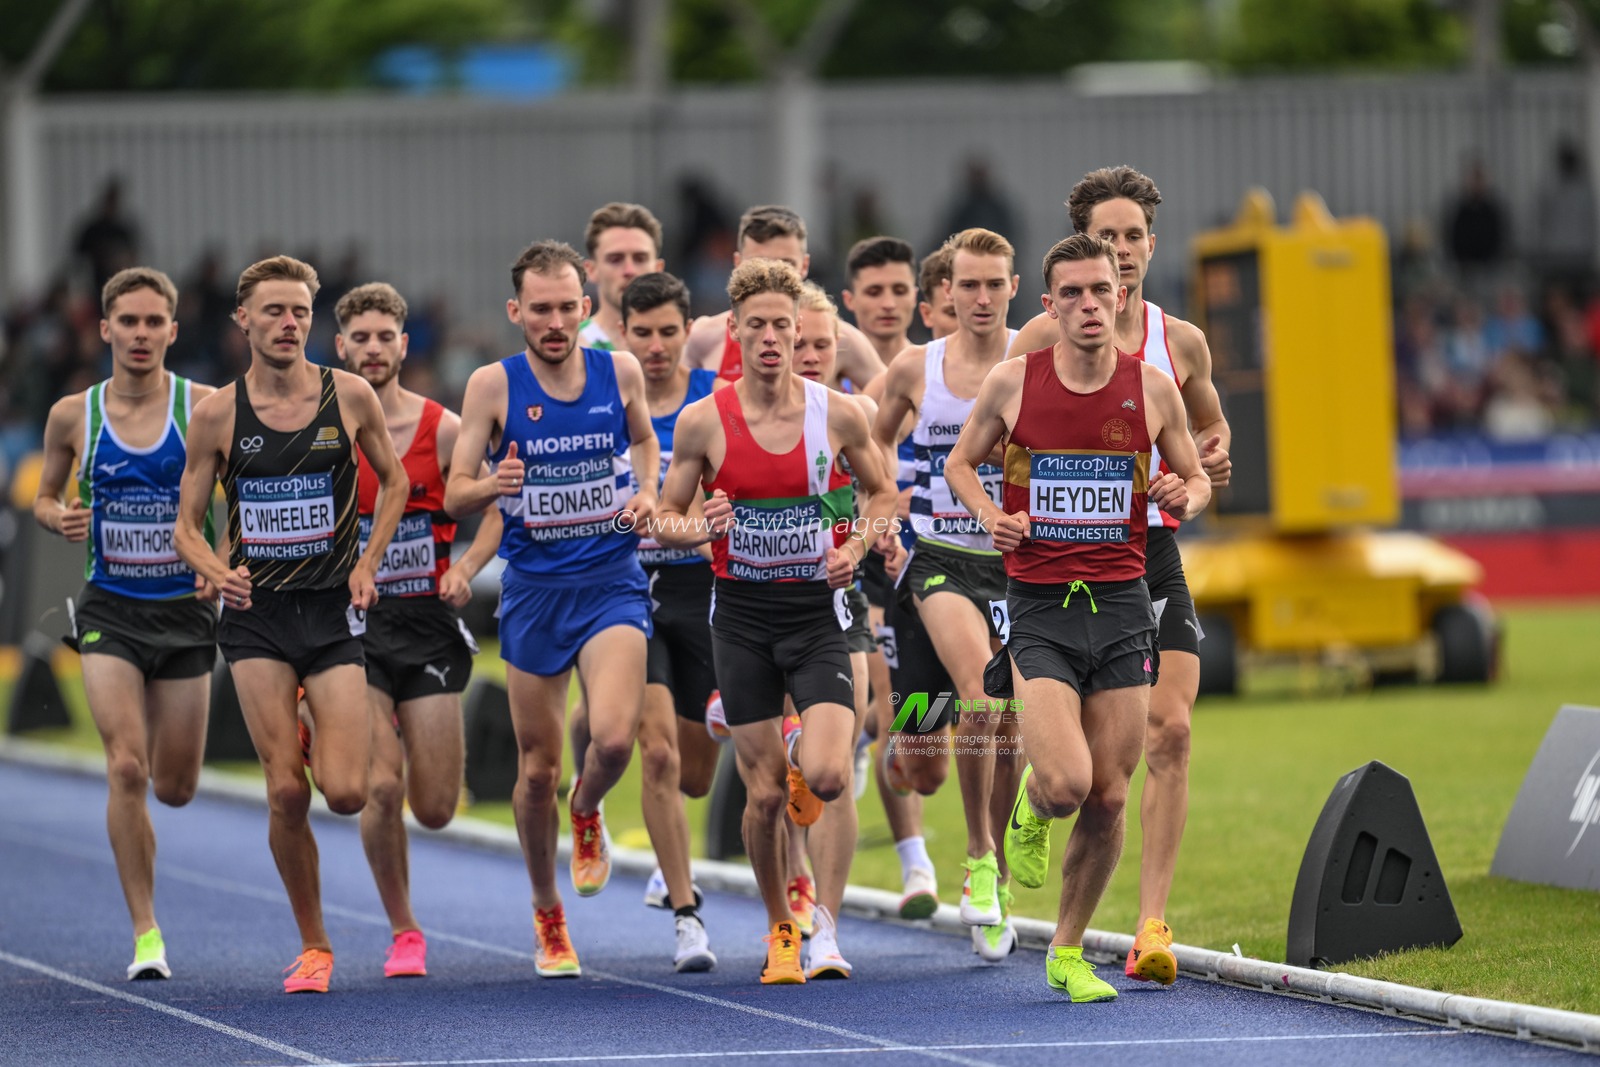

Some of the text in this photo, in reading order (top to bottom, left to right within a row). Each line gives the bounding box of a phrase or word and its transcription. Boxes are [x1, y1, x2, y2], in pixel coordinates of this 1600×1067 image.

[928, 424, 963, 436] TONB
[526, 432, 614, 456] MORPETH
[528, 458, 610, 482] Microplus
[1037, 456, 1128, 479] Microplus
[242, 476, 326, 499] Microplus
[528, 484, 613, 516] LEONARD
[1036, 486, 1125, 513] HEYDEN
[106, 501, 178, 522] Microplu
[244, 503, 330, 532] C WHEELER
[733, 505, 816, 527] Microplus
[1045, 517, 1078, 525] ATHLETICS
[106, 528, 176, 553] MANTHOR
[531, 522, 614, 540] MANCHESTER
[1035, 525, 1123, 540] MANCHESTER
[247, 541, 328, 557] MANCHESTER
[732, 529, 818, 558] BARNICOAT
[363, 544, 430, 571] AGANO
[637, 549, 699, 563] ANCHESTE
[109, 562, 187, 578] MANCHESTER
[732, 563, 817, 580] MANCHESTER
[376, 578, 430, 595] CHESTER
[992, 606, 1006, 639] 2
